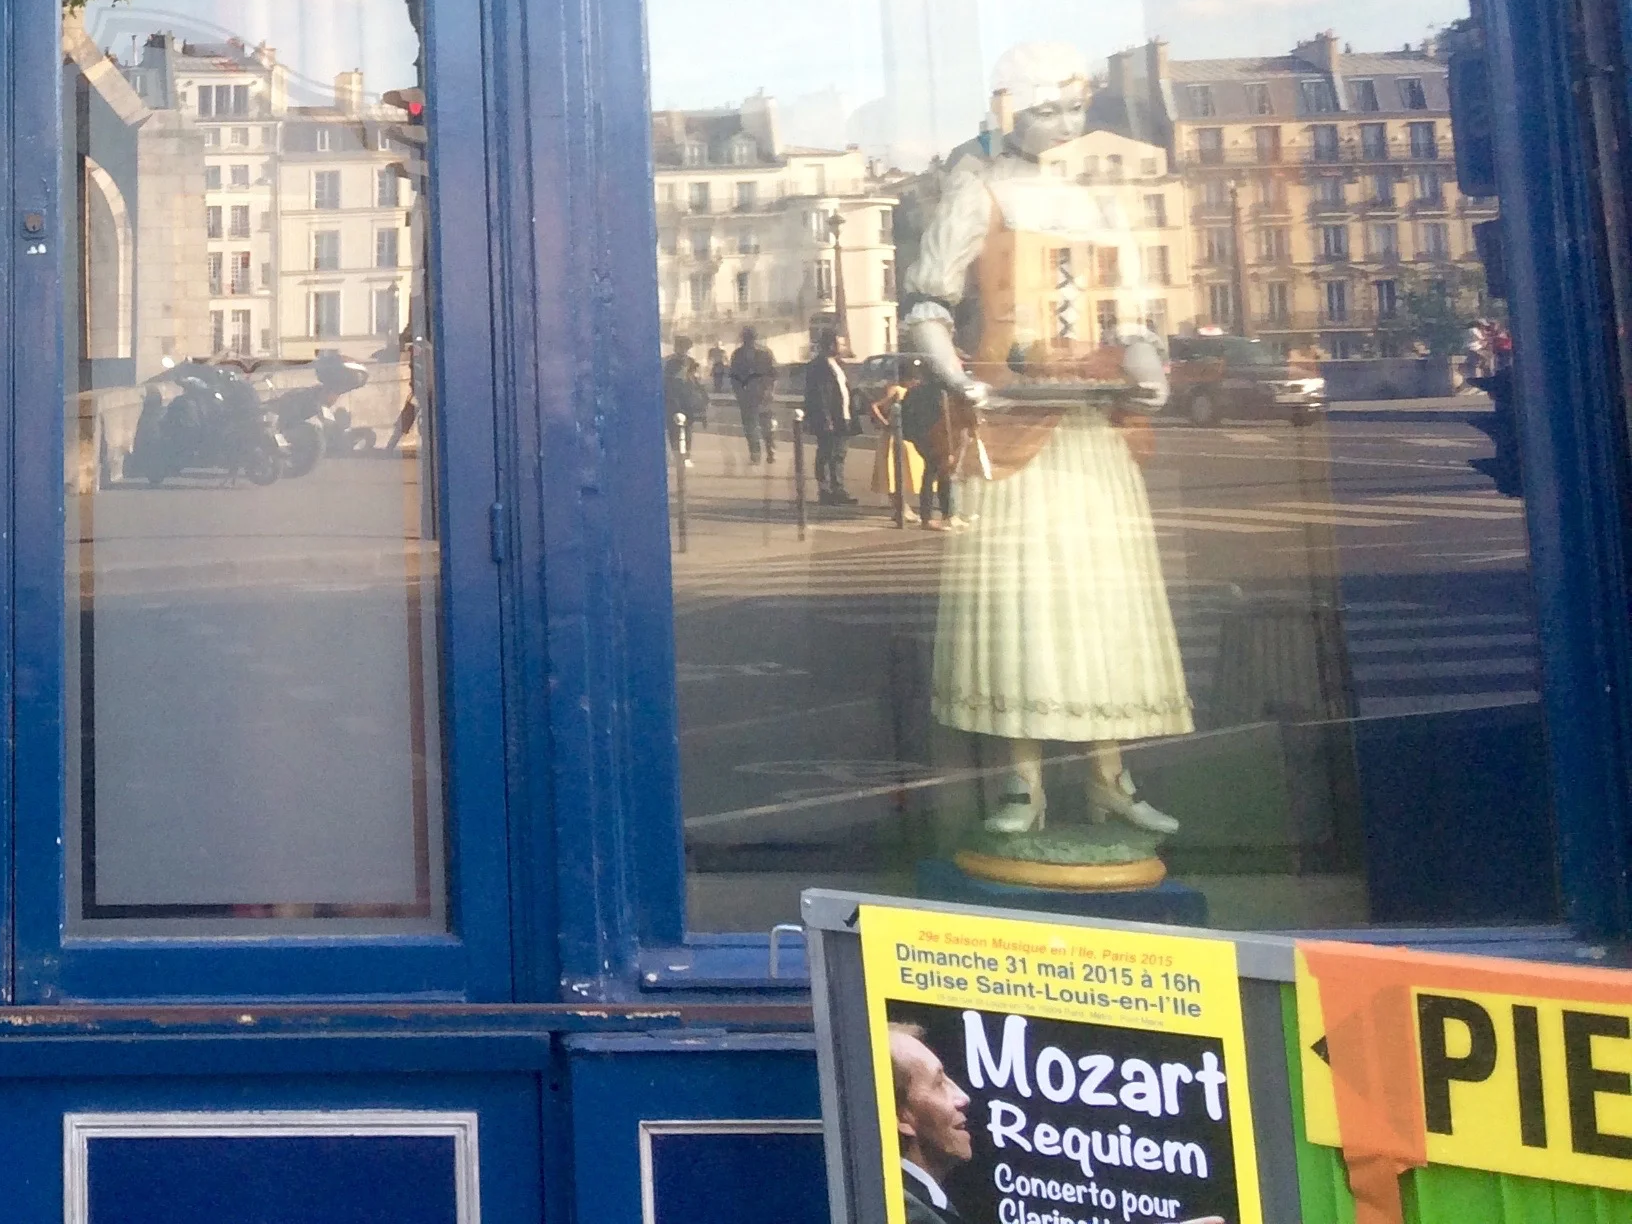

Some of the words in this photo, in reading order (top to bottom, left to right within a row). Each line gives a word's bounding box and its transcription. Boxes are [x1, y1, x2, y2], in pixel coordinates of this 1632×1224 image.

[896, 943, 999, 971] Dimanche
[1005, 955, 1028, 974] 31
[1037, 962, 1075, 980] mai
[1082, 963, 1133, 986] 2015
[1140, 969, 1153, 988] à
[1161, 972, 1201, 993] 16h
[918, 930, 940, 943] 29e
[944, 932, 987, 947] Saison
[991, 937, 1047, 955] Musique
[1050, 946, 1067, 956] en
[1102, 949, 1137, 964] Paris
[1141, 953, 1173, 967] 2015
[900, 967, 968, 991] Eglise
[976, 975, 1202, 1017] Saint-Louis-en-l'Ile
[962, 1010, 1227, 1121] Mozart
[986, 1100, 1209, 1178] Requiem
[994, 1163, 1116, 1209] Concerto
[1122, 1189, 1181, 1222] pour
